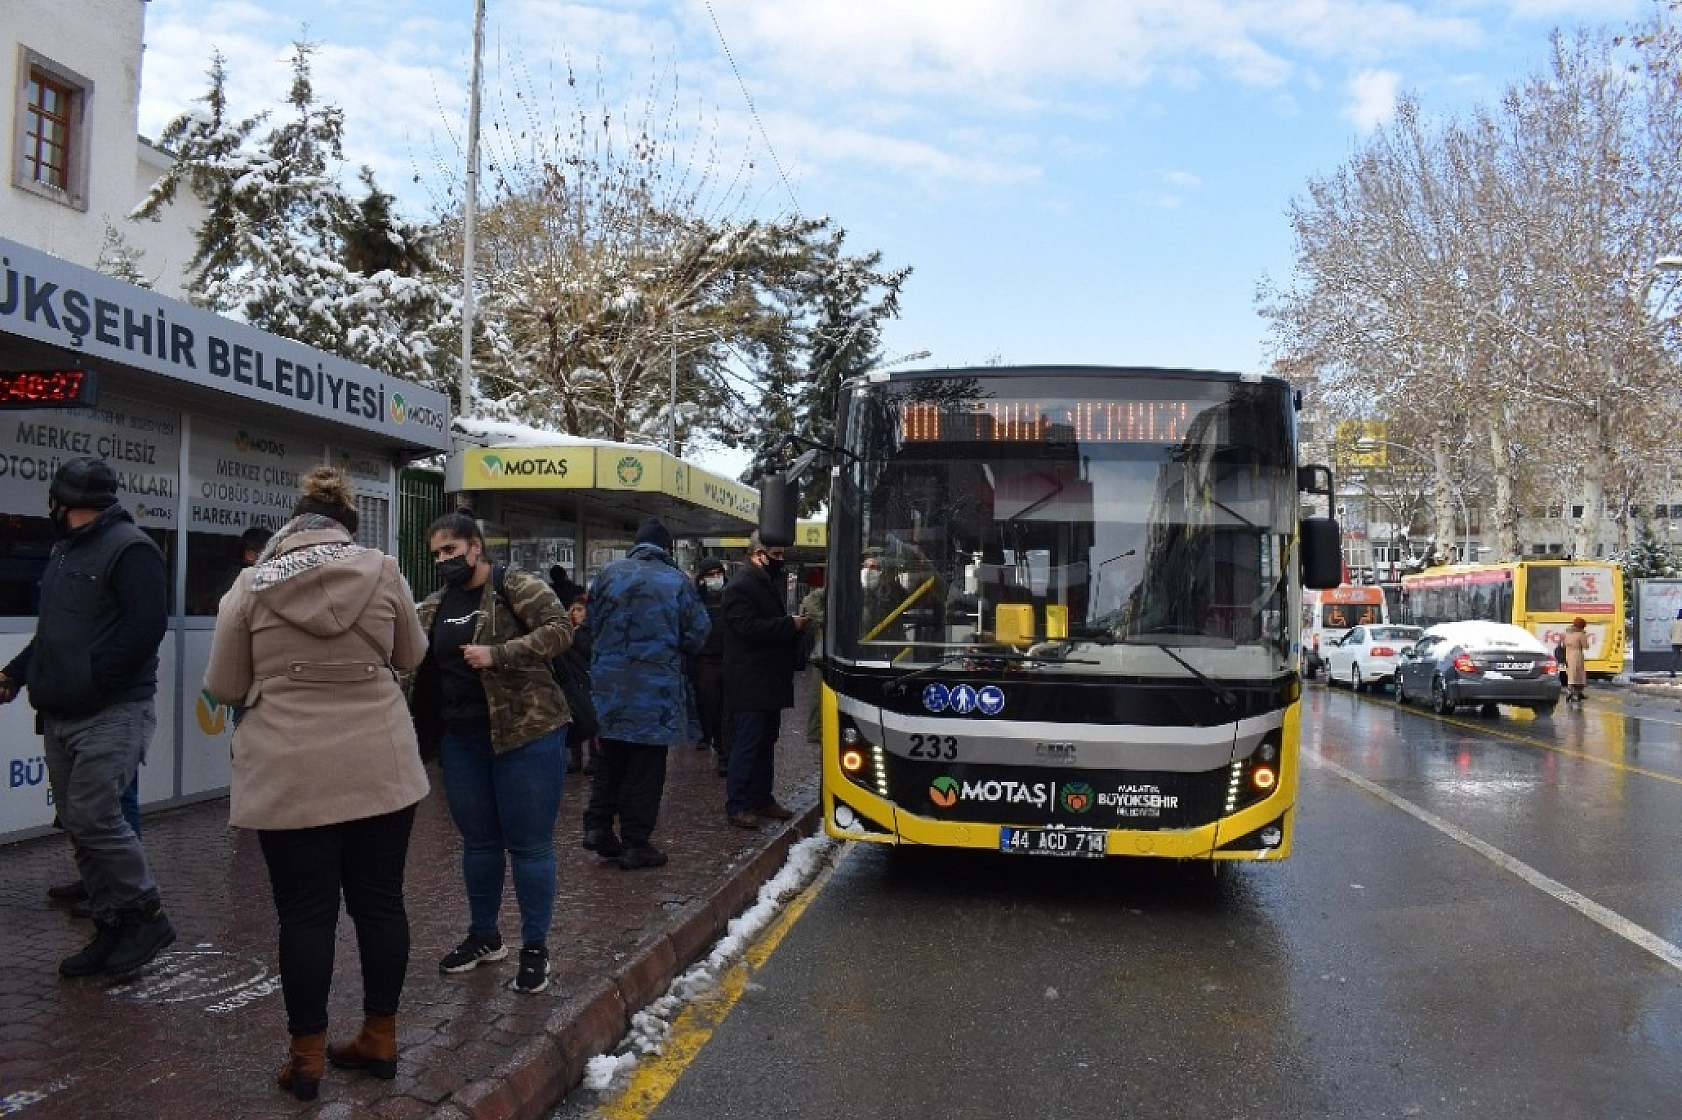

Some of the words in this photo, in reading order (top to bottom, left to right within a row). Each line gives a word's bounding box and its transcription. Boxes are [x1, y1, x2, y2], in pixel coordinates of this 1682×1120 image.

[208, 336, 385, 422] BELEDİYESİ
[407, 404, 443, 432] MOTAŞ
[16, 421, 91, 454] MERKEZ
[98, 433, 156, 465] ÇİLESİZ
[251, 438, 285, 460] MOTAŞ
[217, 458, 260, 482] MERKEZ
[263, 465, 300, 489] ÇİLESİZ
[504, 458, 568, 479] MOTAŞ
[202, 481, 248, 504] OTOBÜS
[252, 489, 298, 509] DURAKL
[193, 505, 248, 528] HAREKAT
[908, 733, 958, 760] 233
[960, 780, 1048, 809] MOTAŞ
[1011, 830, 1029, 849] 44
[1039, 832, 1067, 850] ACD
